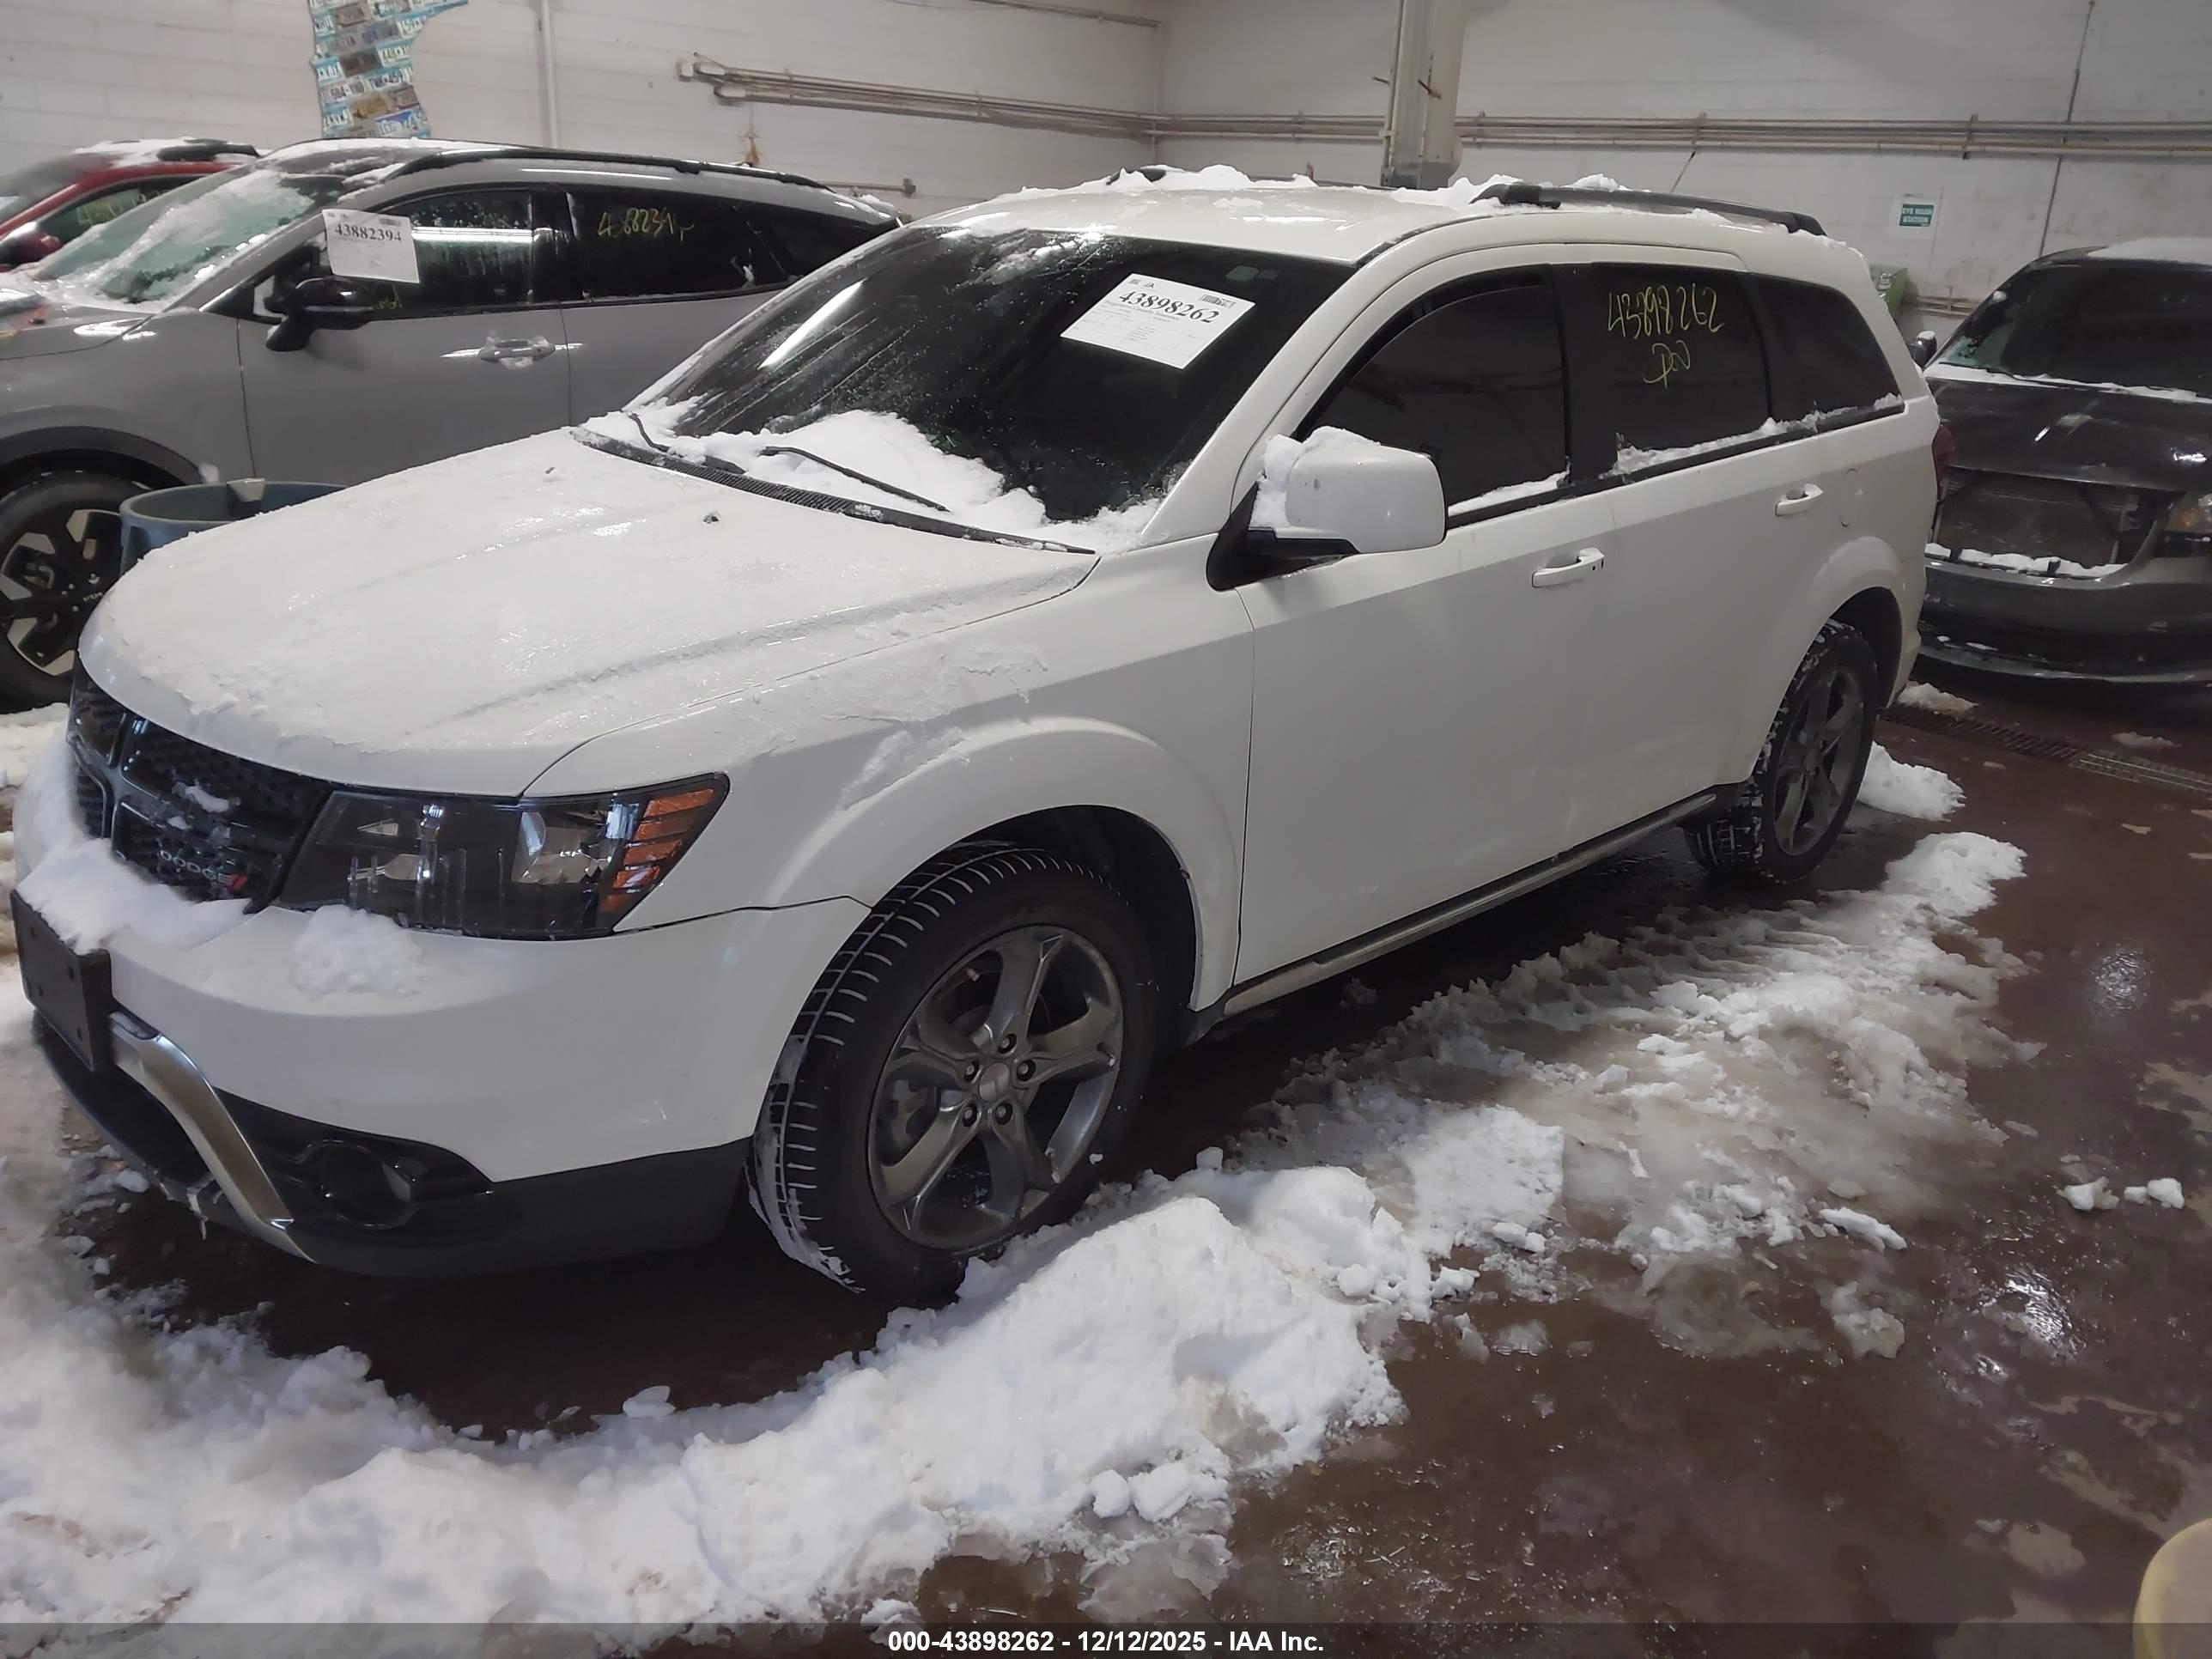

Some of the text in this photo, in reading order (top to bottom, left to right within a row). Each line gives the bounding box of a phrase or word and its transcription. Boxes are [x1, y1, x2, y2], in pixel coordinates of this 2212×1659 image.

[335, 223, 402, 241] 43882394
[1119, 290, 1219, 324] 43898262
[1607, 283, 1725, 339] 43898262
[157, 848, 234, 885] DODGE
